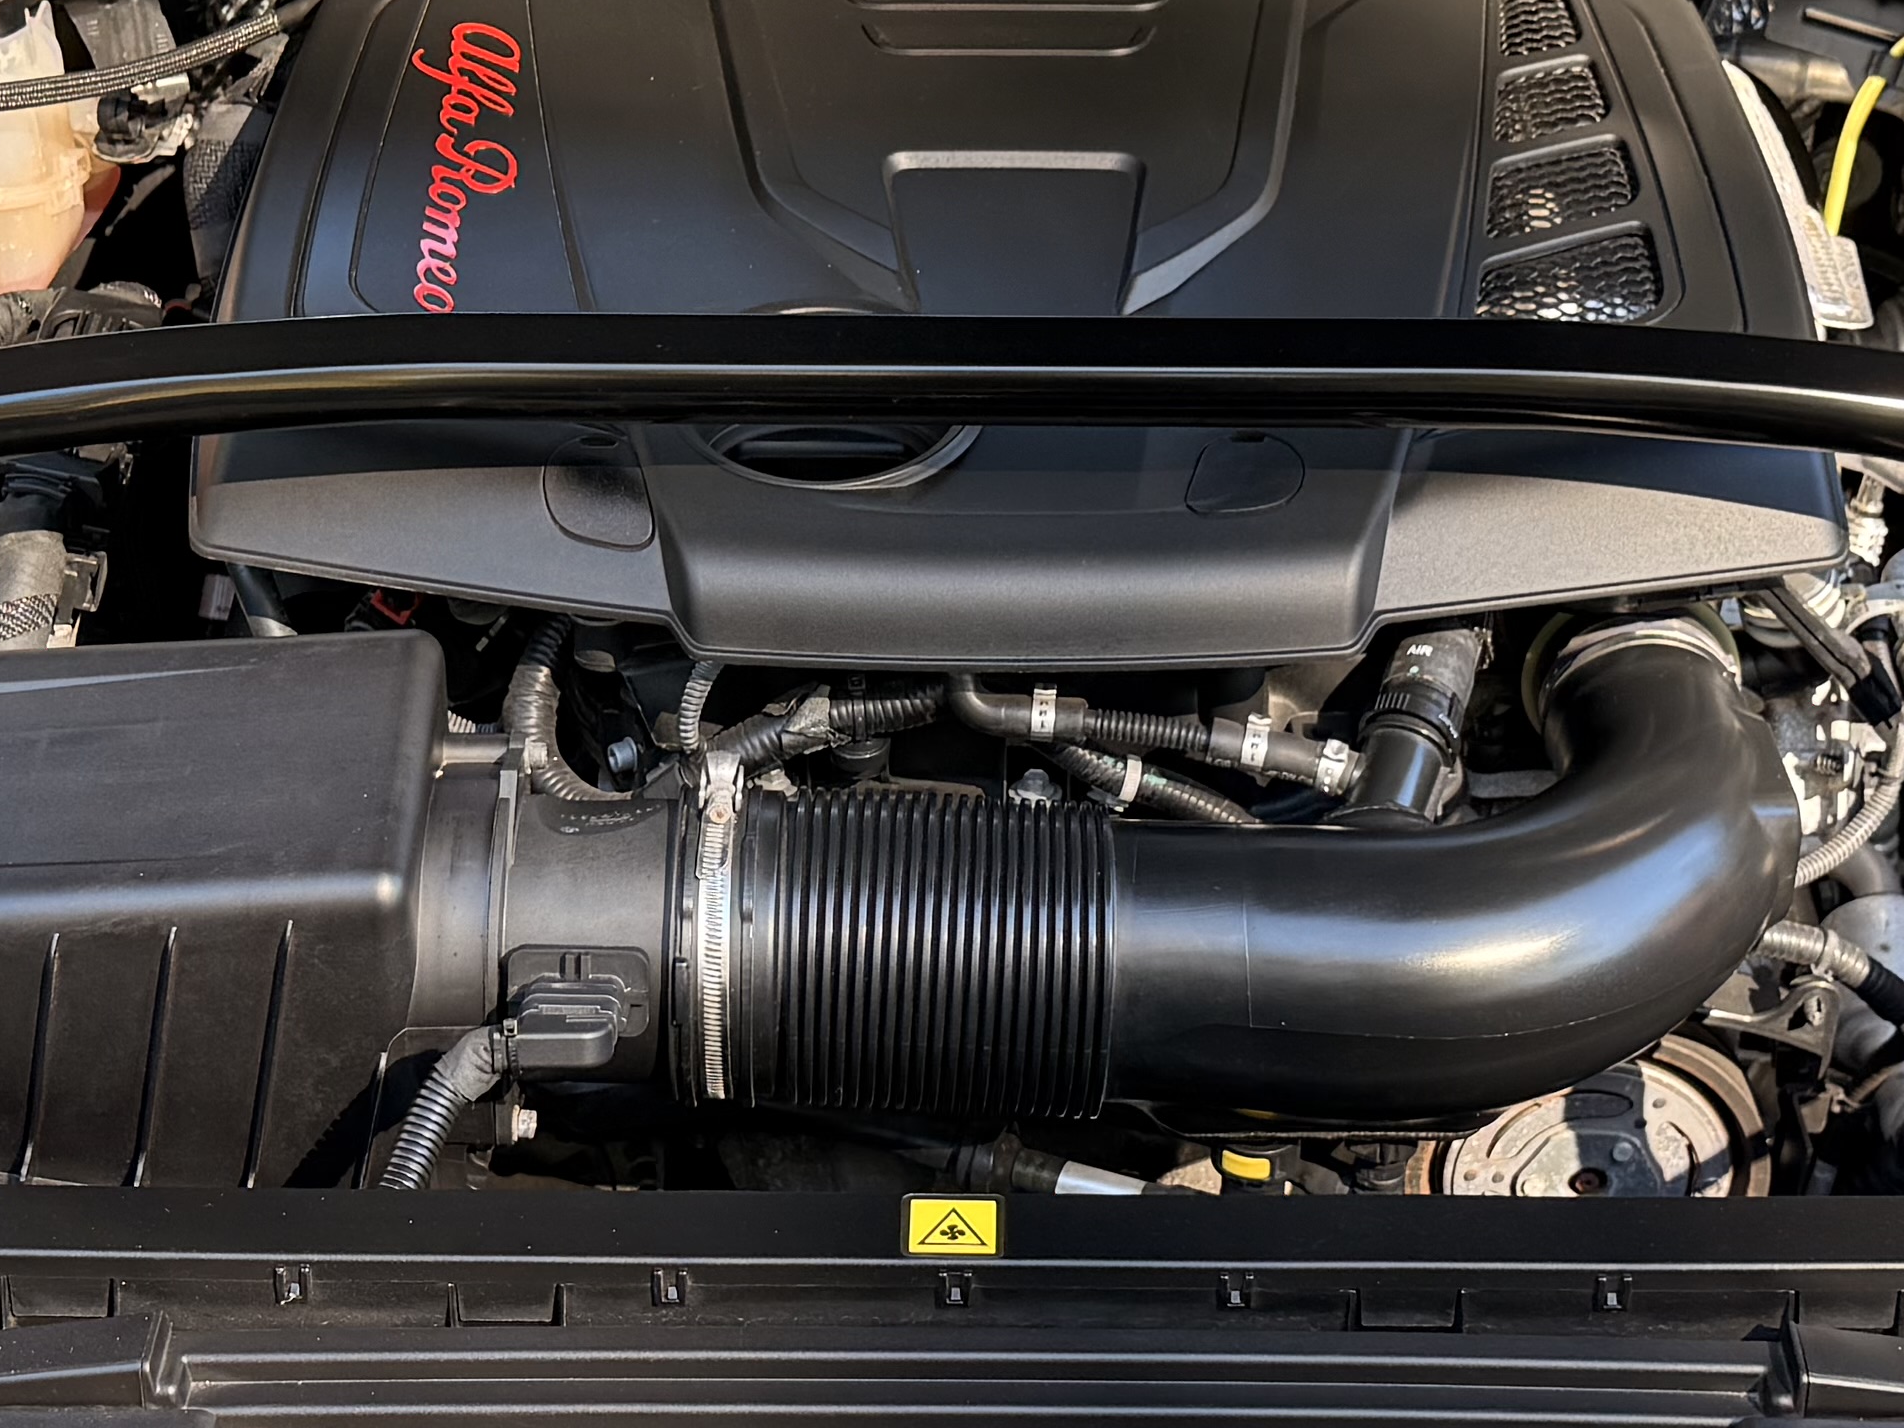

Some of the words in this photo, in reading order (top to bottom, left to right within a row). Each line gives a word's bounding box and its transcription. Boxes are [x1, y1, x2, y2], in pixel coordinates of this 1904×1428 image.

[412, 23, 521, 135] Alfa
[414, 134, 518, 314] Romeo
[1407, 644, 1434, 657] AIR
